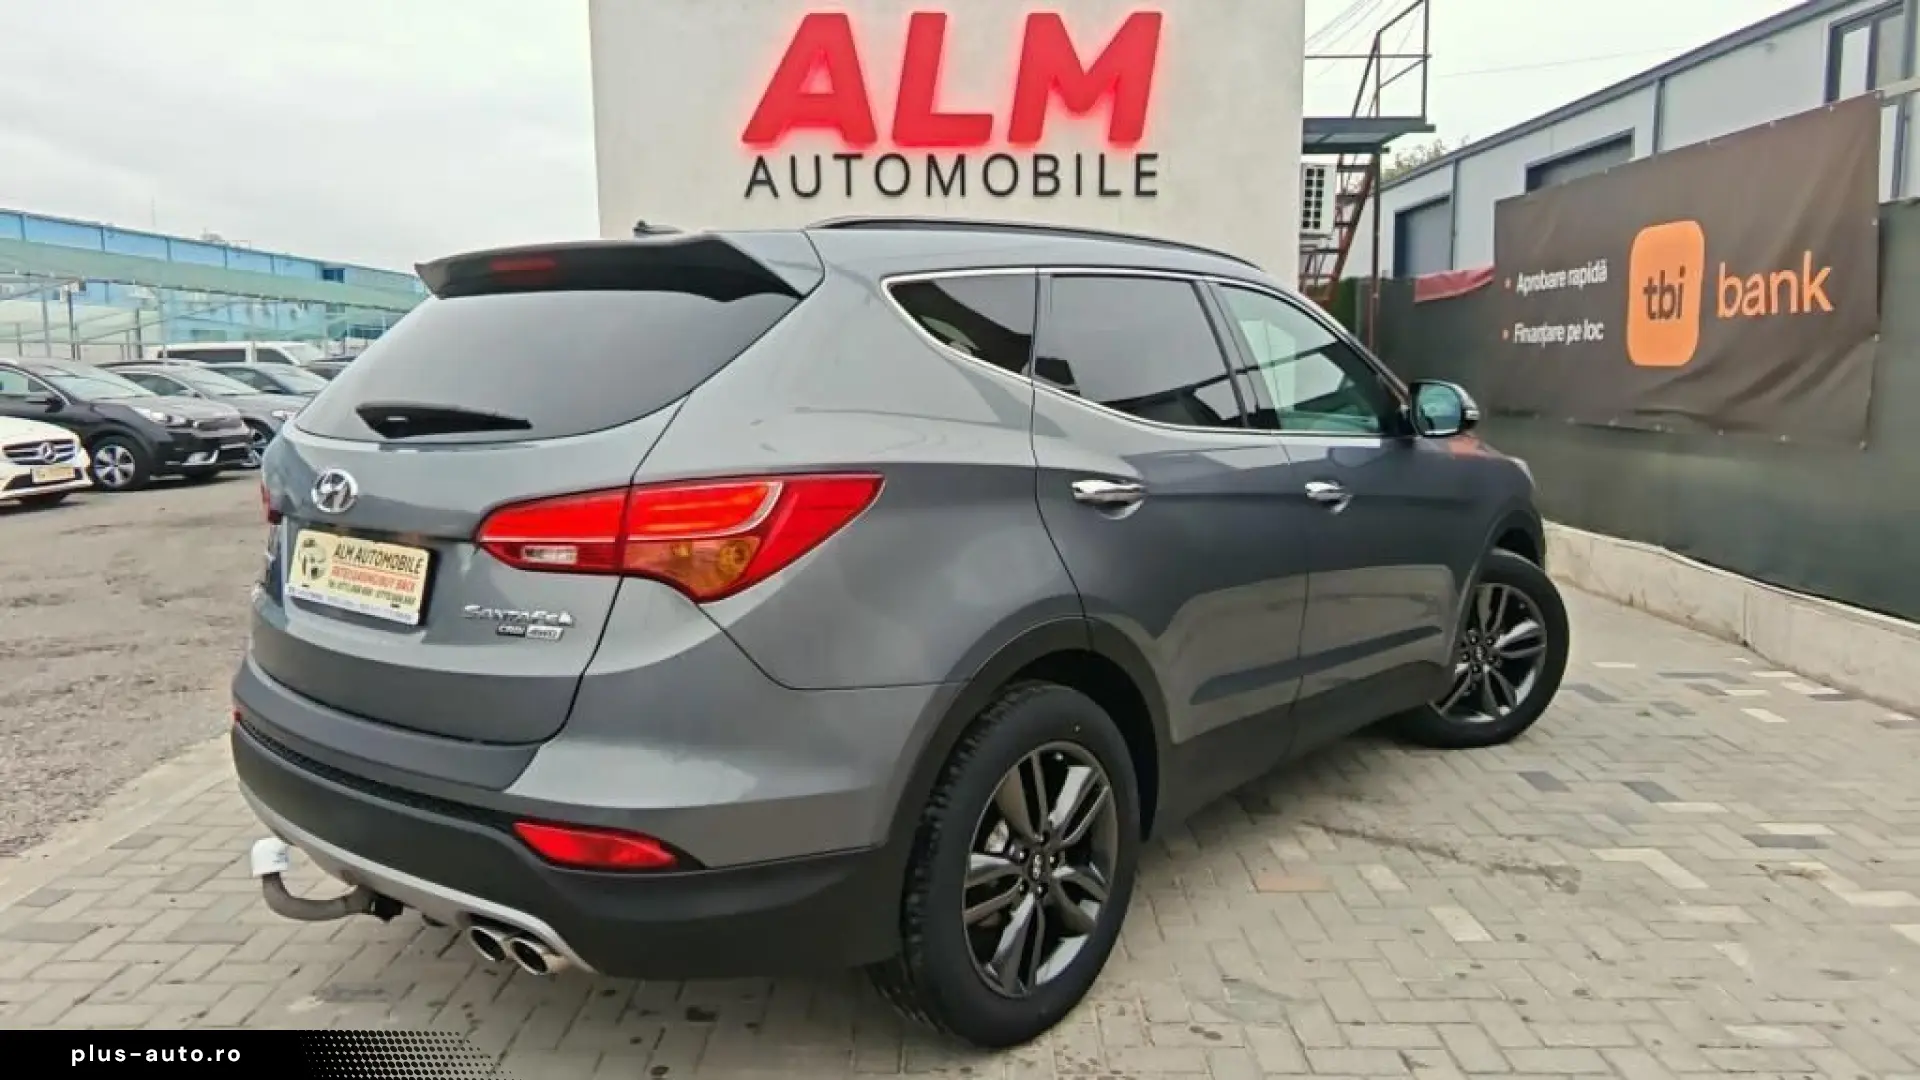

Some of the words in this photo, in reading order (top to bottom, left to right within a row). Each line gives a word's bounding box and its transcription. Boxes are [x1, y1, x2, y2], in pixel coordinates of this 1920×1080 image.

[742, 12, 1163, 145] ALM
[743, 152, 1159, 198] AUTOMOBILE
[1516, 269, 1567, 296] Aprobare
[1568, 258, 1608, 290] rapidă
[1643, 266, 1686, 320] tbi
[1716, 250, 1834, 318] bank
[1566, 323, 1582, 345] pe
[1583, 318, 1605, 341] loc
[334, 542, 355, 561] ALM
[355, 547, 425, 574] AUTOMOBILE
